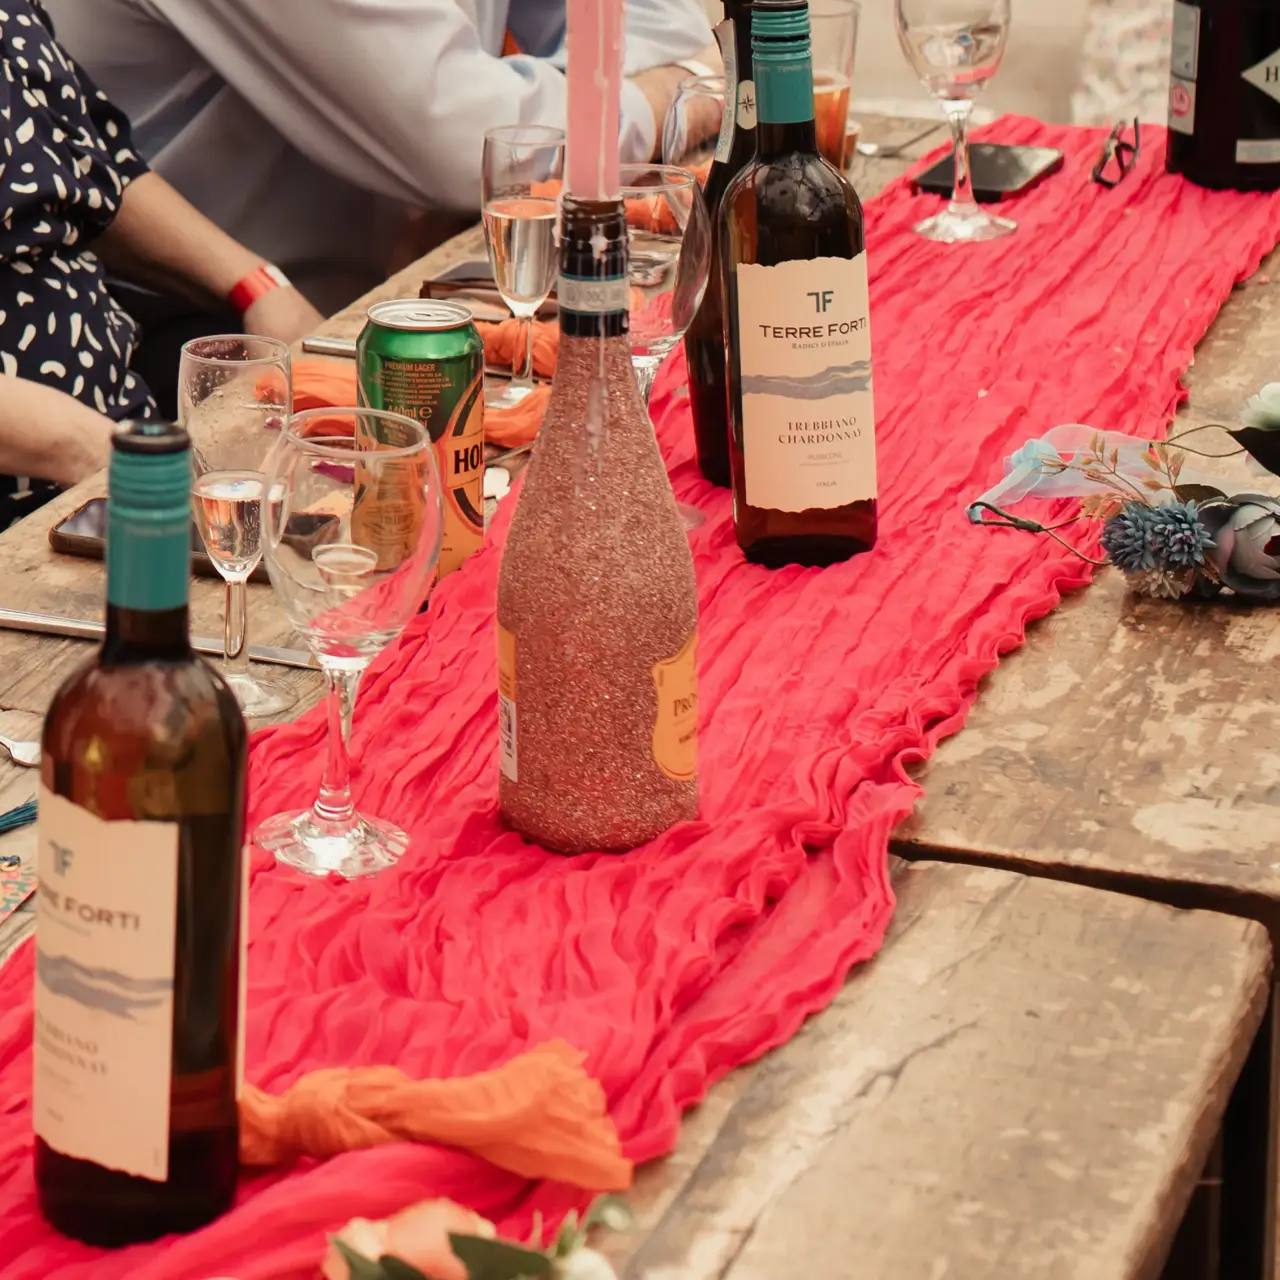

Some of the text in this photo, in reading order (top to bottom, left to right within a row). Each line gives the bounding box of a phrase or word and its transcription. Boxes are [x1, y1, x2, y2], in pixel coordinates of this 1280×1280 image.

[758, 324, 824, 339] TERRE
[385, 361, 436, 372] PREMIUM LAGER
[787, 416, 857, 431] TREBBIANO
[64, 895, 141, 931] FORTI
